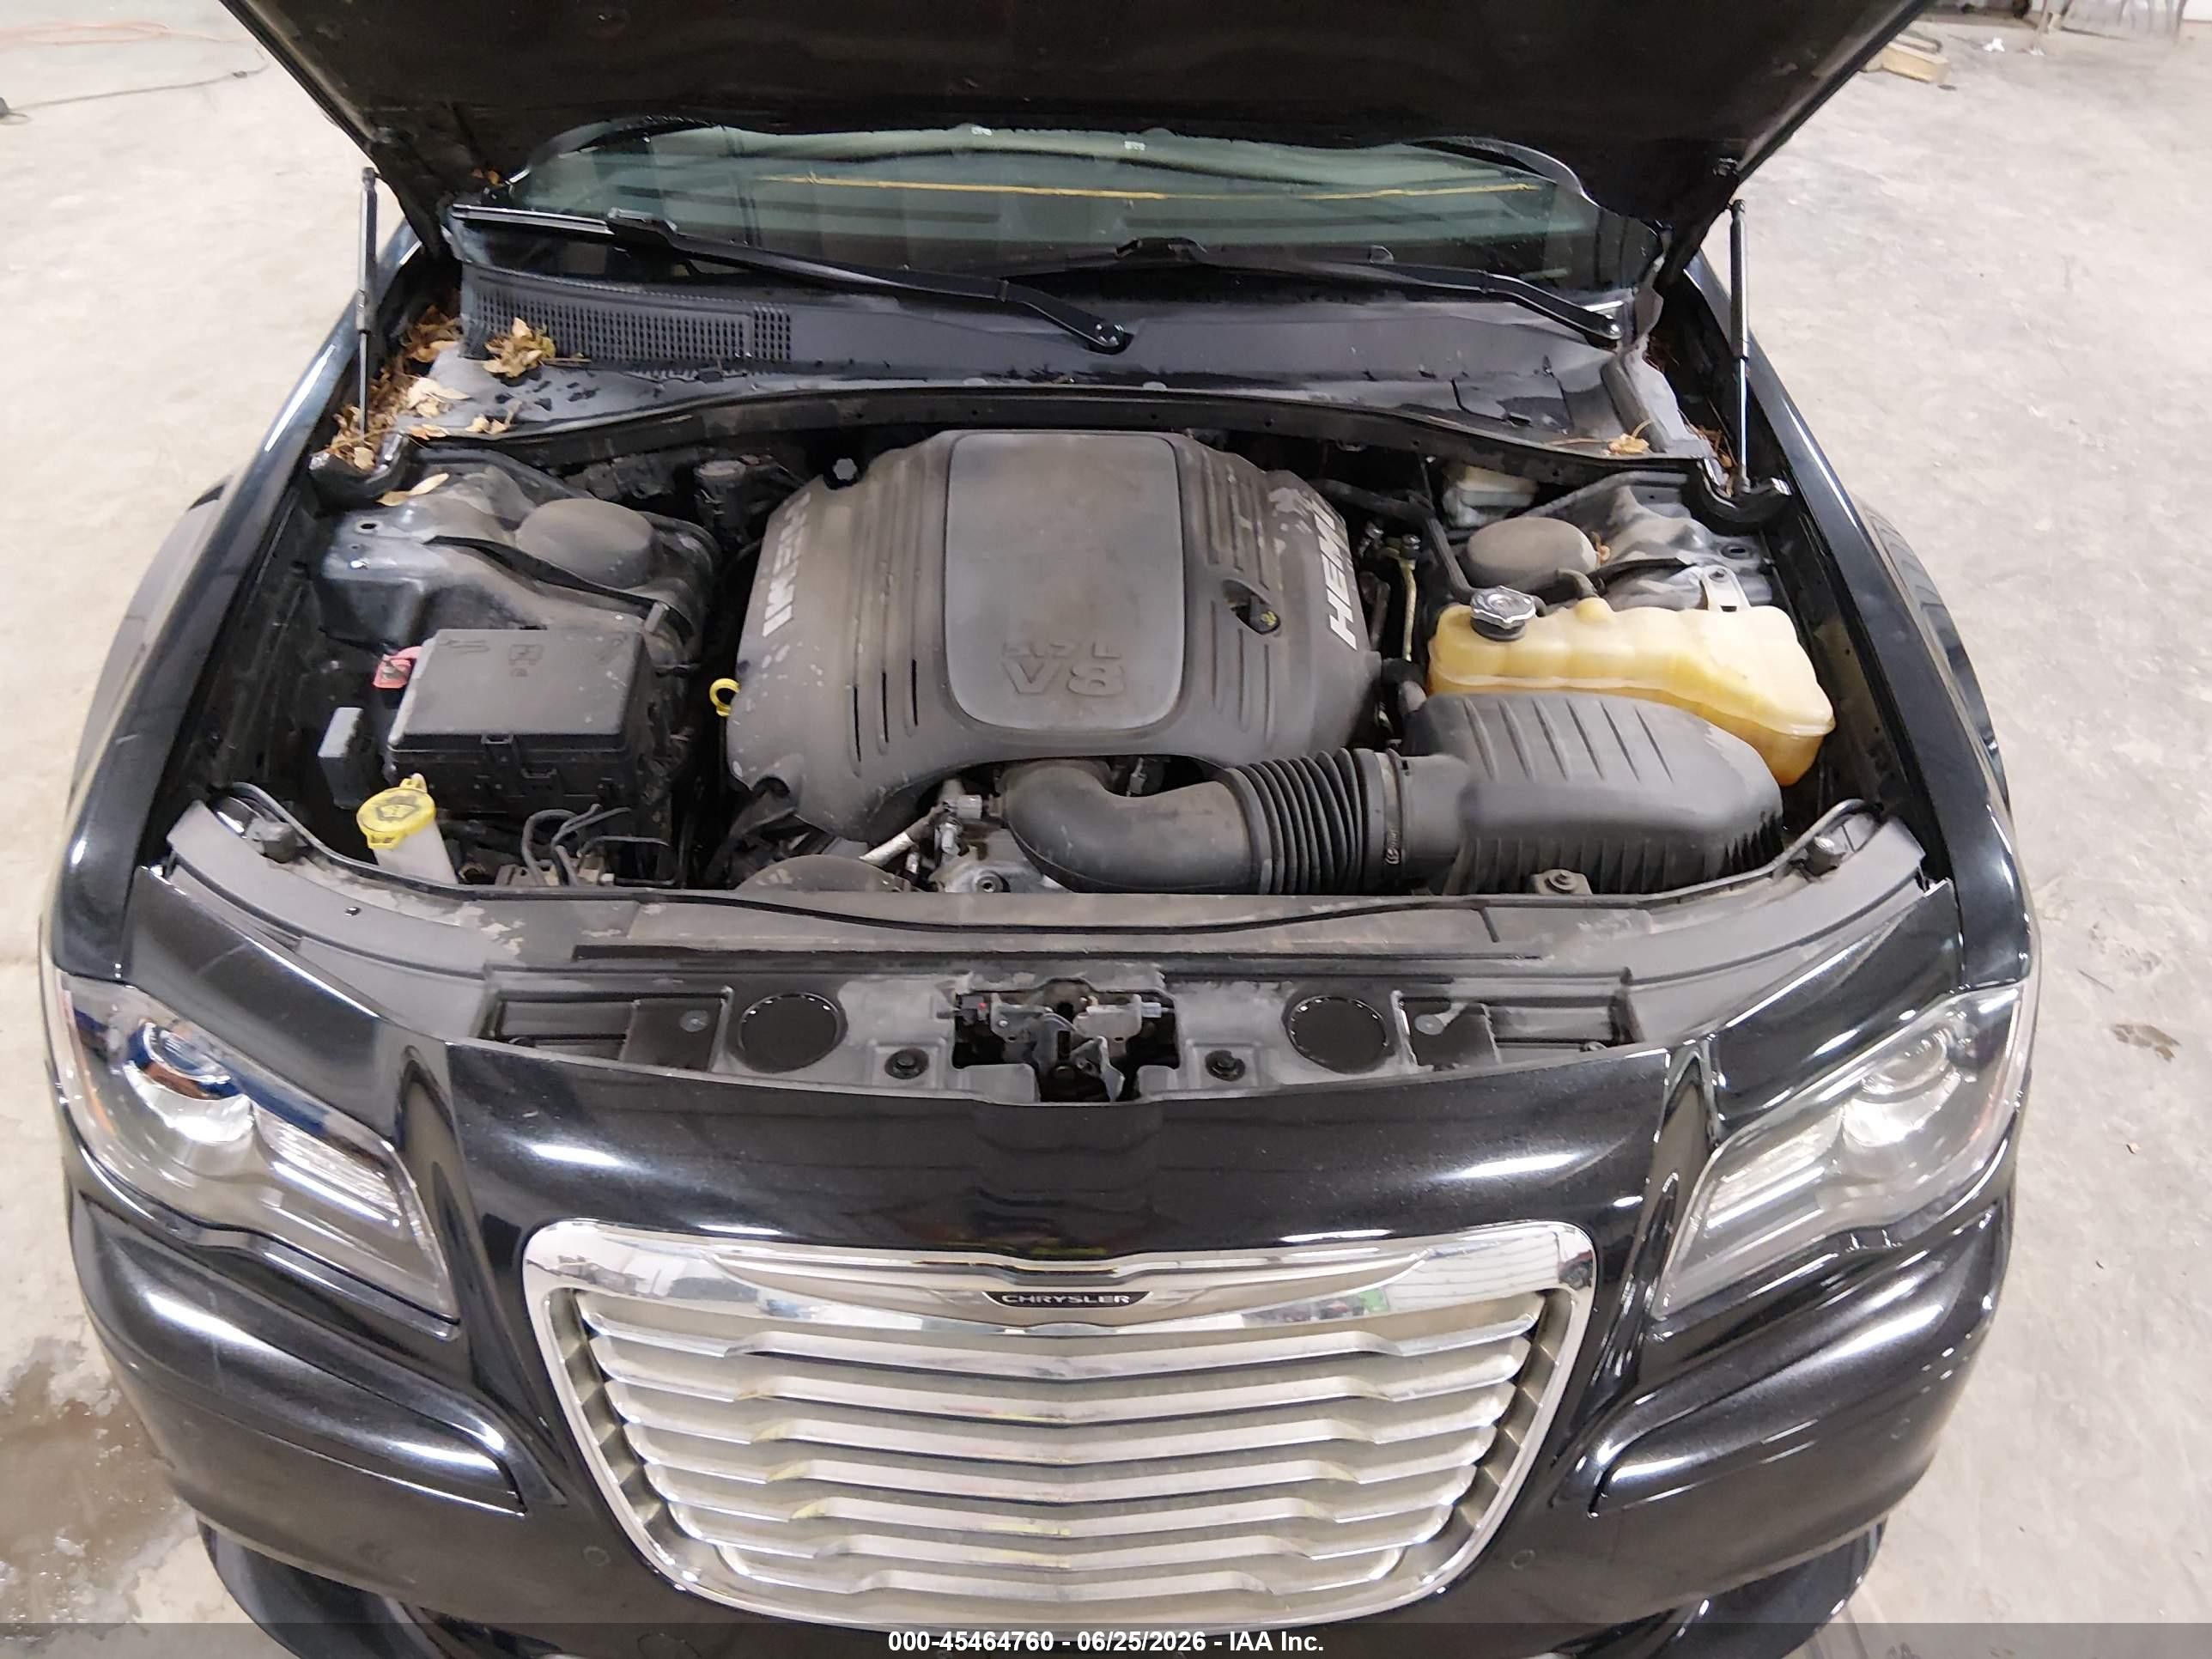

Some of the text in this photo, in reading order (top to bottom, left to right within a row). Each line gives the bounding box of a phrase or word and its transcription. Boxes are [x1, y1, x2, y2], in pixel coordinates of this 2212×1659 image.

[1310, 498, 1358, 651] HEMI
[1000, 660, 1127, 697] V8
[1001, 1295, 1132, 1304] CHRYSLER
